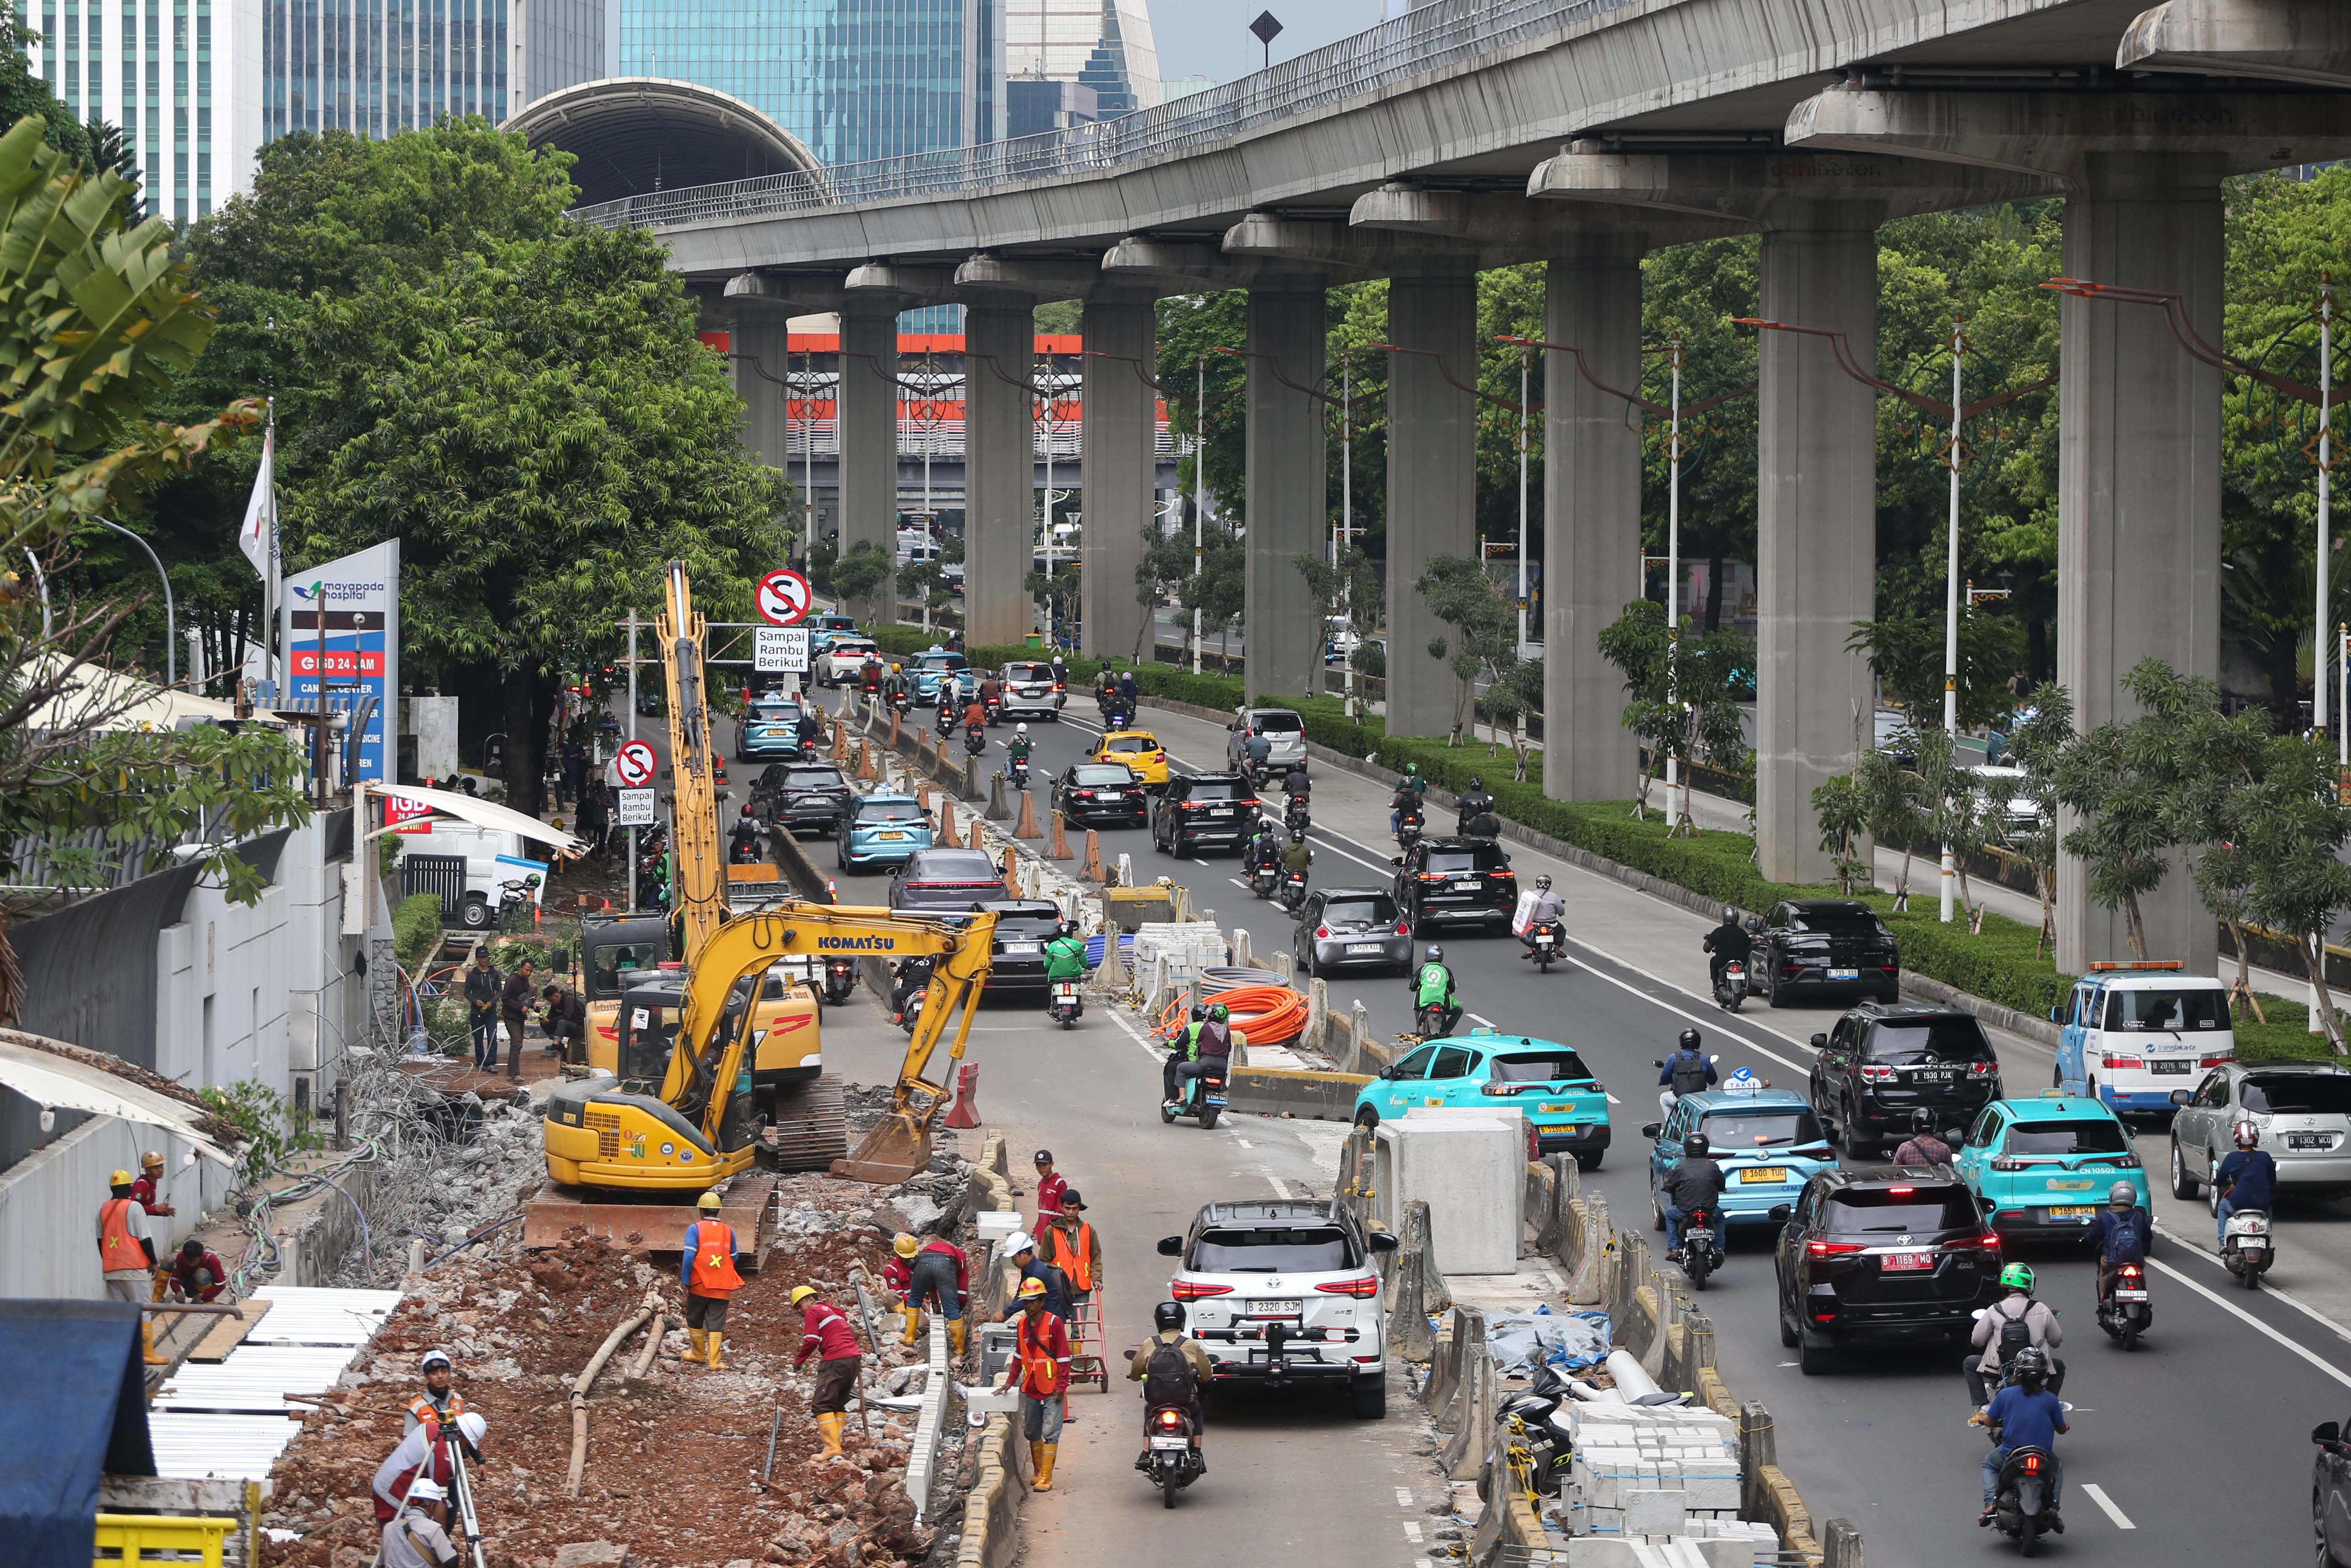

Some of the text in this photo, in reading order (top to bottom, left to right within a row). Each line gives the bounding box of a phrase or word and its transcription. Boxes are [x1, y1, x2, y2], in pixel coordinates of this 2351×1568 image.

[324, 582, 384, 592] mayapada
[324, 590, 365, 601] hospital
[759, 632, 805, 644] Sampai
[760, 645, 803, 655] Rambu
[337, 658, 350, 669] 24
[759, 657, 804, 667] Berikut
[621, 791, 652, 801] Sampai
[392, 797, 427, 812] IGD
[623, 802, 650, 812] Rambu
[623, 812, 651, 822] Berikut
[818, 935, 894, 950] KOMATSU
[2158, 1044, 2195, 1052] transjakarta
[1750, 1169, 1767, 1177] 1600
[1771, 1167, 1785, 1176] TUC
[1883, 1256, 1888, 1265] B
[1896, 1255, 1913, 1265] 1169
[1248, 1301, 1300, 1311] B 2320 SJM
